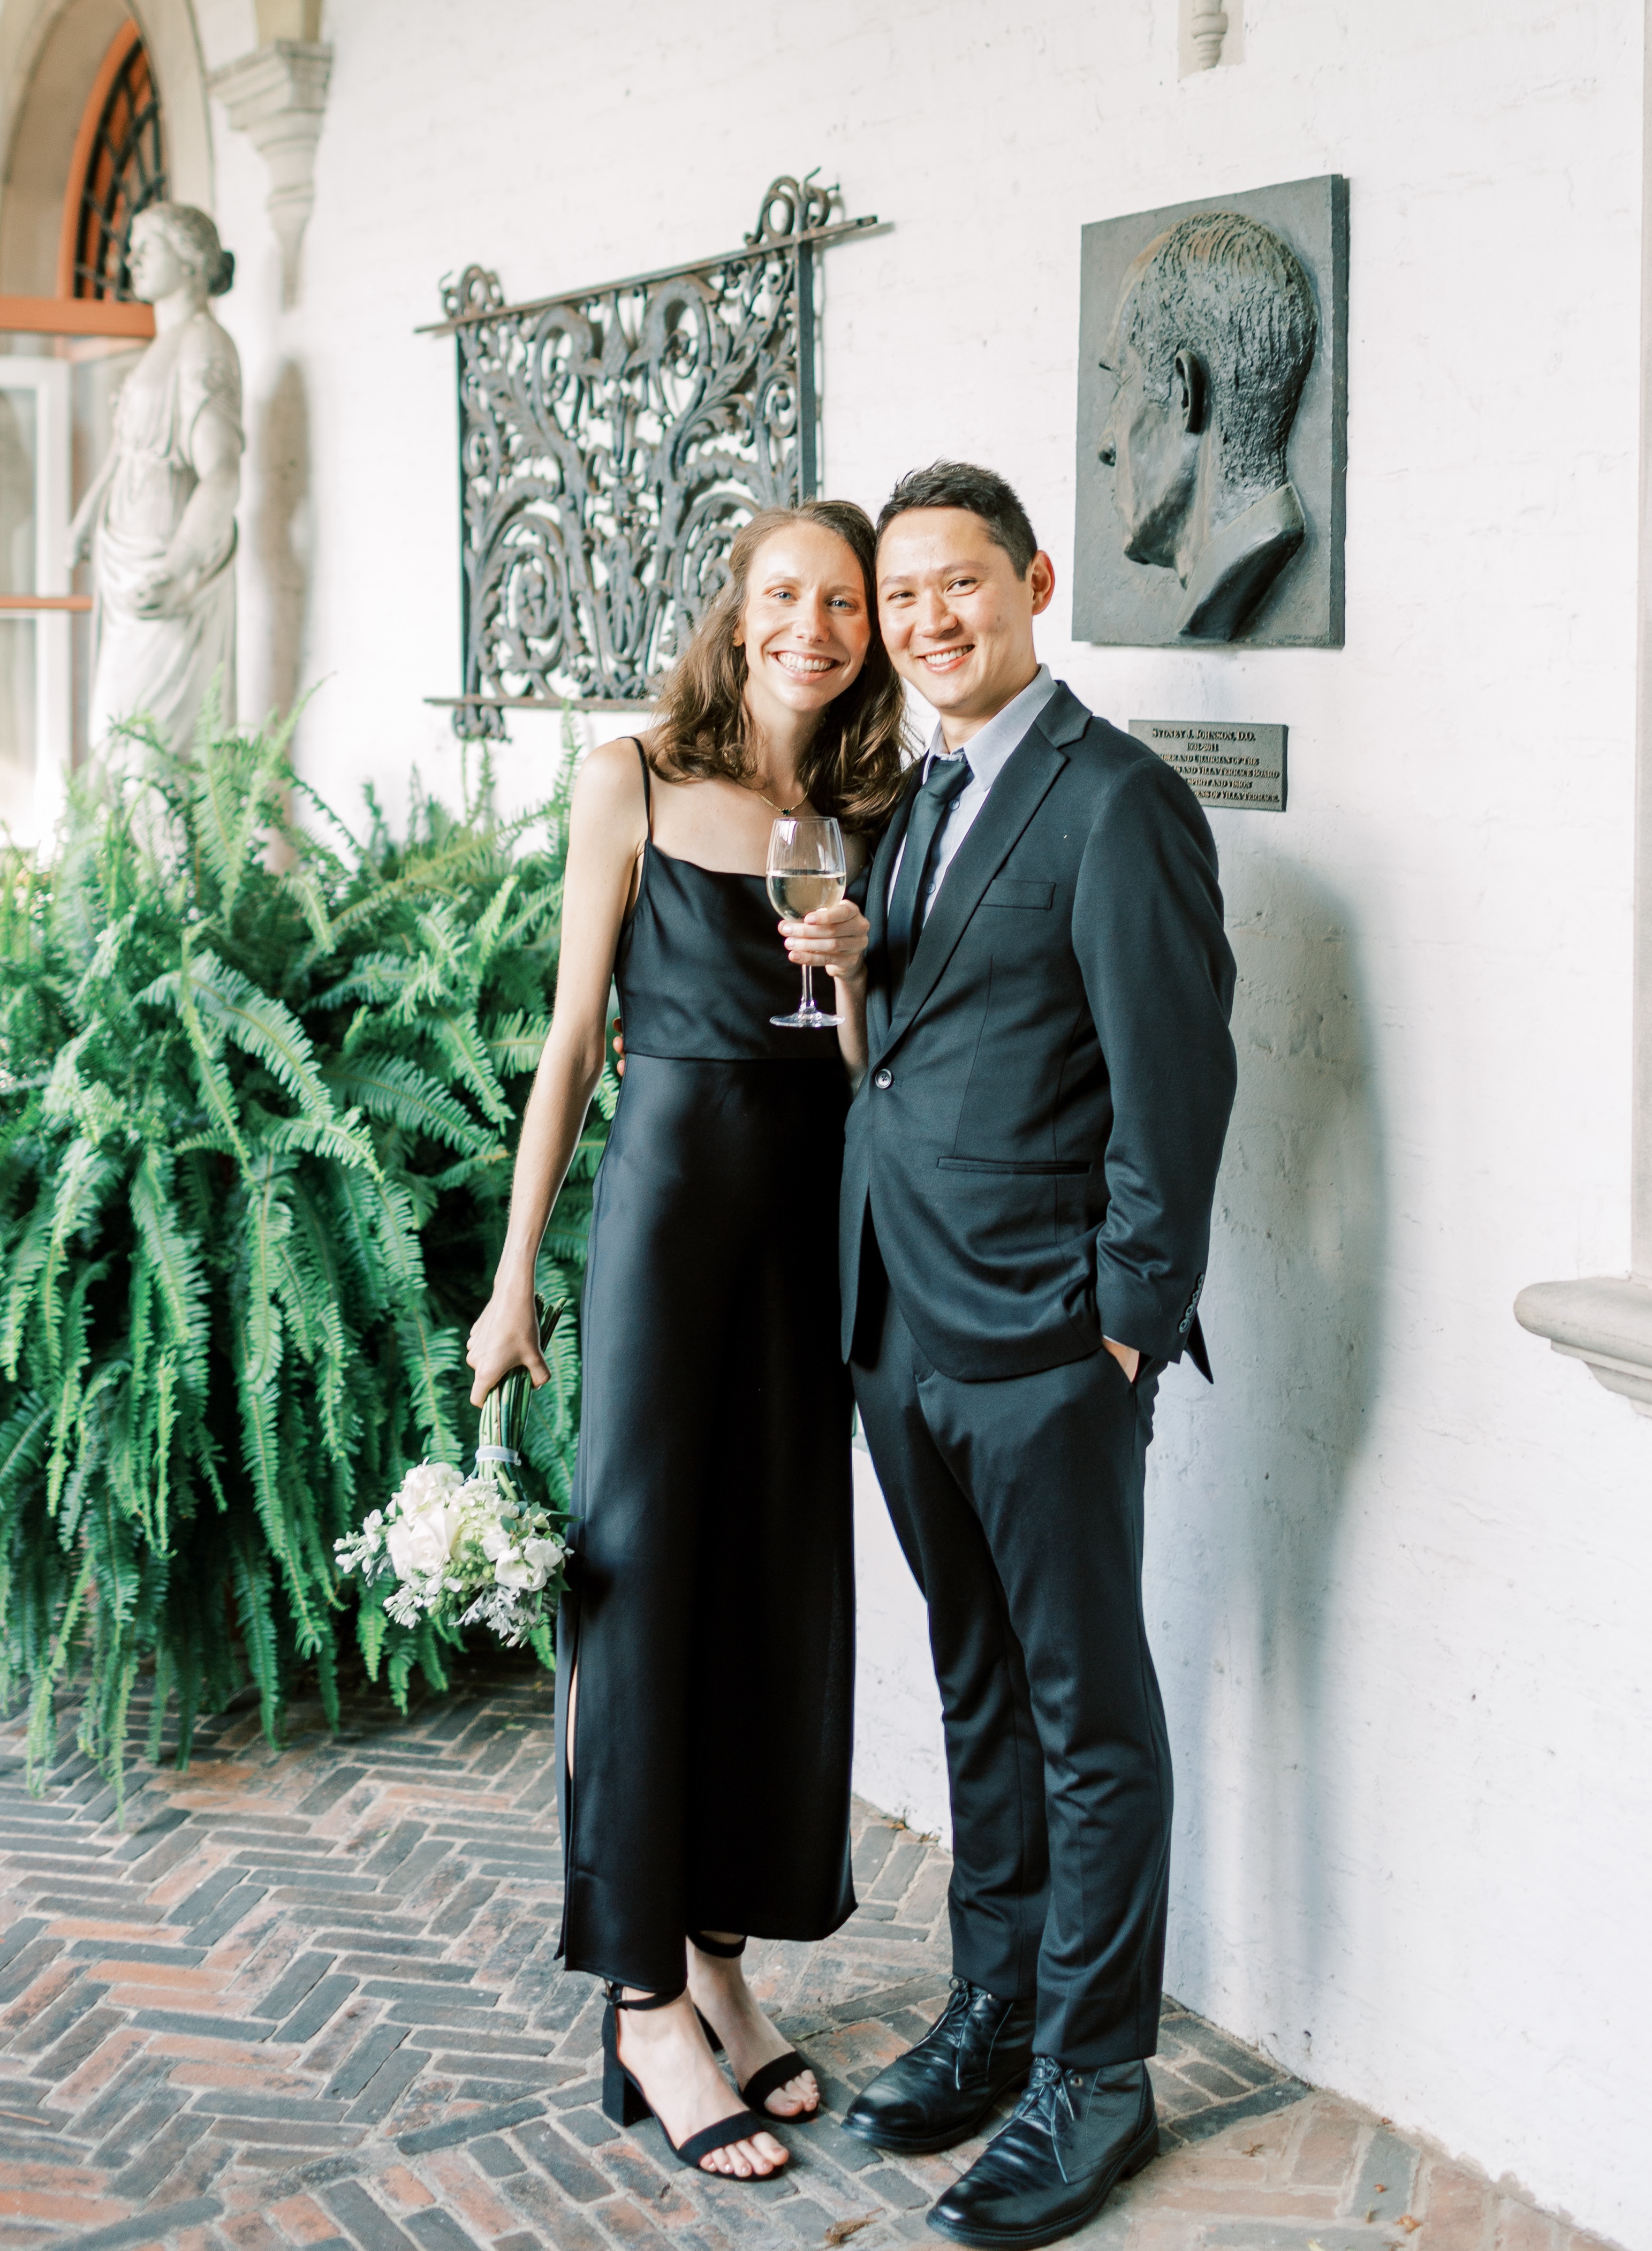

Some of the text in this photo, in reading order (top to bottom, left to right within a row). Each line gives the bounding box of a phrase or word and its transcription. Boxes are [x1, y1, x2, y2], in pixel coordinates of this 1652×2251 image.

[1152, 728, 1186, 738] SYDNEY
[1187, 729, 1194, 739] J.
[1237, 731, 1256, 741] D.O.
[1179, 754, 1193, 762] AND
[1193, 754, 1232, 764] CHAIRMAN
[1232, 756, 1242, 764] OF
[1242, 756, 1260, 766] THE
[1197, 766, 1219, 775] VILLA
[1219, 767, 1253, 777] TERRACE
[1253, 769, 1280, 778] BOARD
[1227, 780, 1253, 789] VISION
[1210, 791, 1221, 799] OF
[1221, 791, 1243, 800] VILLA
